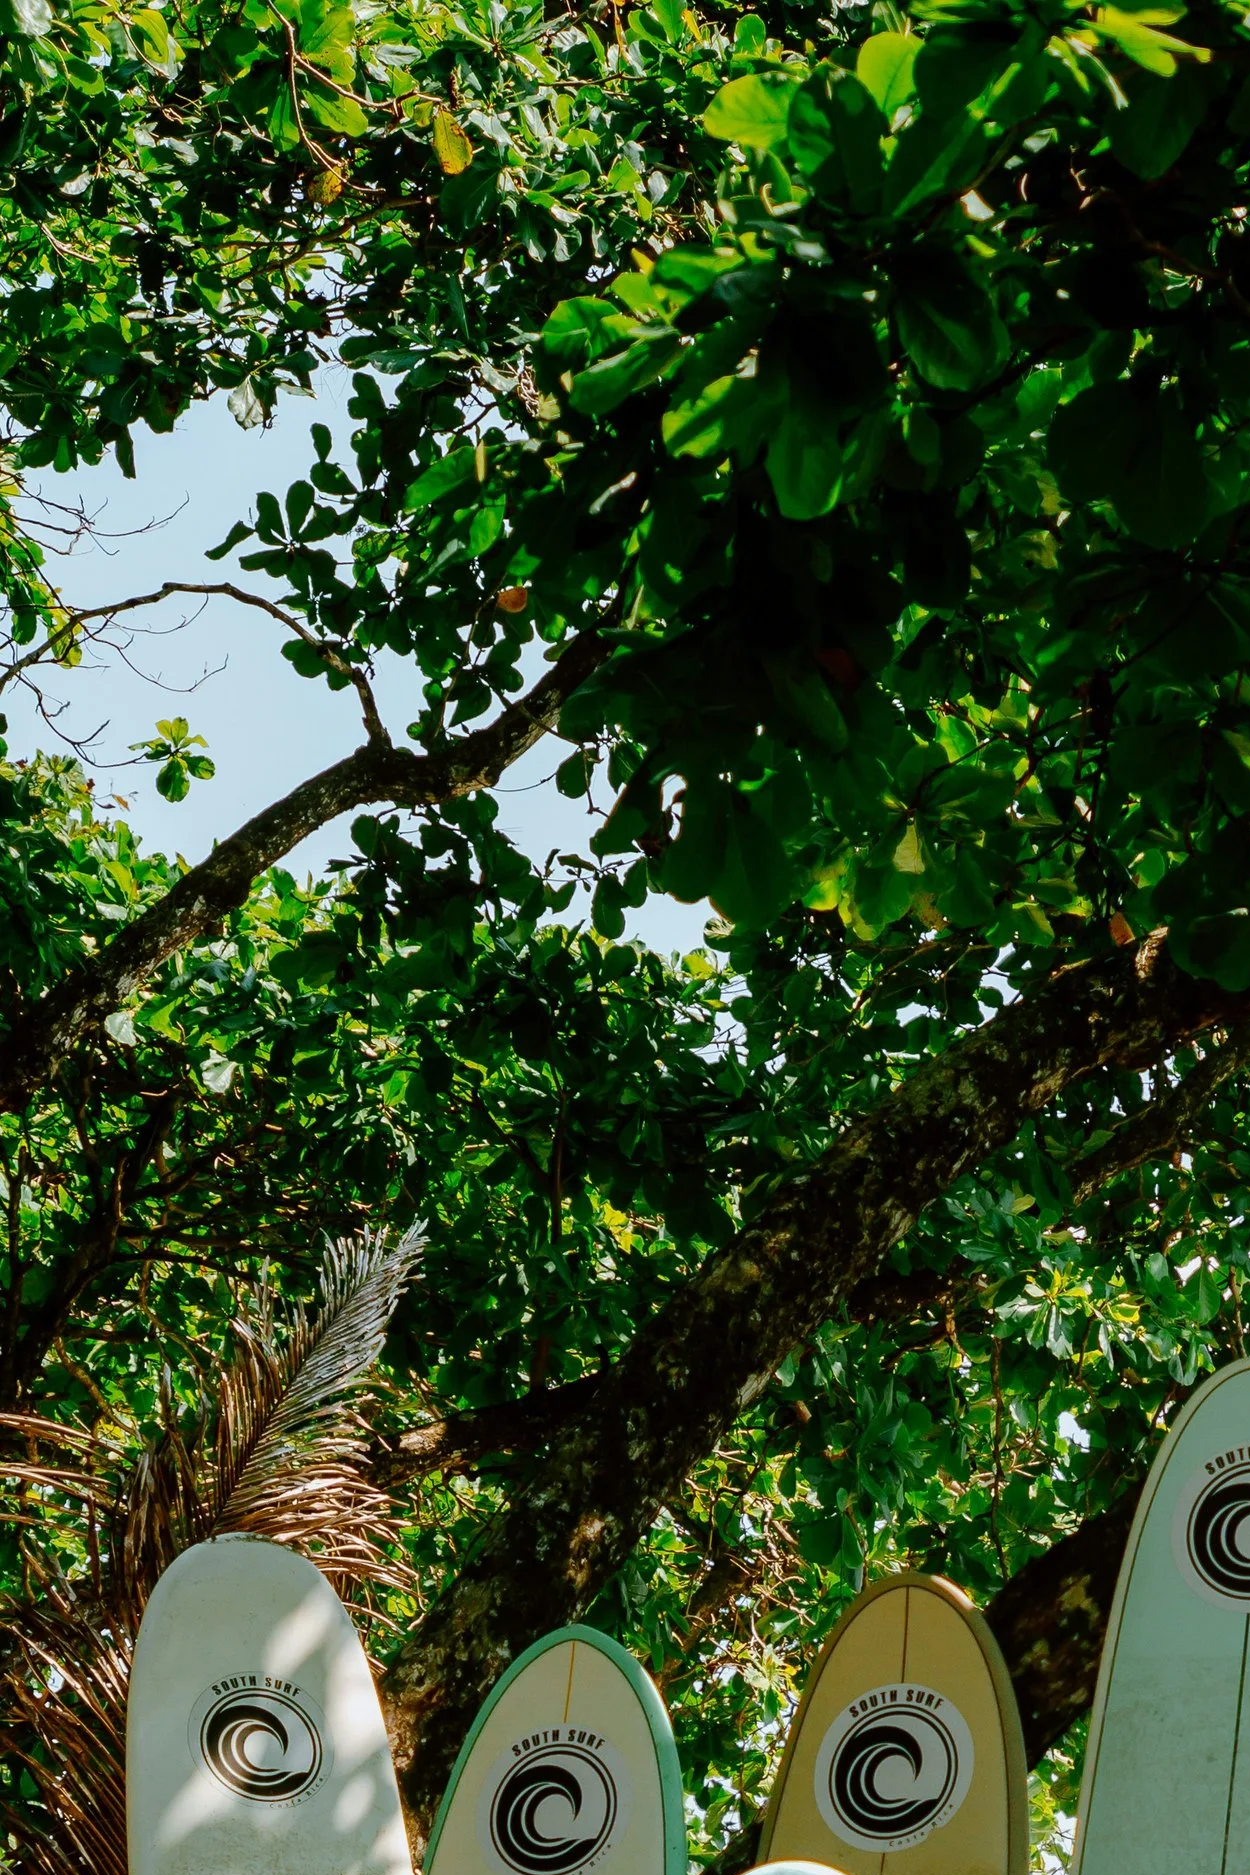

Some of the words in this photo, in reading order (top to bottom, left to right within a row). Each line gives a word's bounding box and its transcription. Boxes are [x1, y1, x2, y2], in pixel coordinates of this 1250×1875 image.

[211, 1675, 257, 1696] SOUTH
[264, 1676, 302, 1697] SURF
[849, 1689, 899, 1718] SOUTH
[905, 1689, 944, 1710] SURF
[511, 1729, 560, 1757] SOUTH
[567, 1728, 606, 1750] SURF
